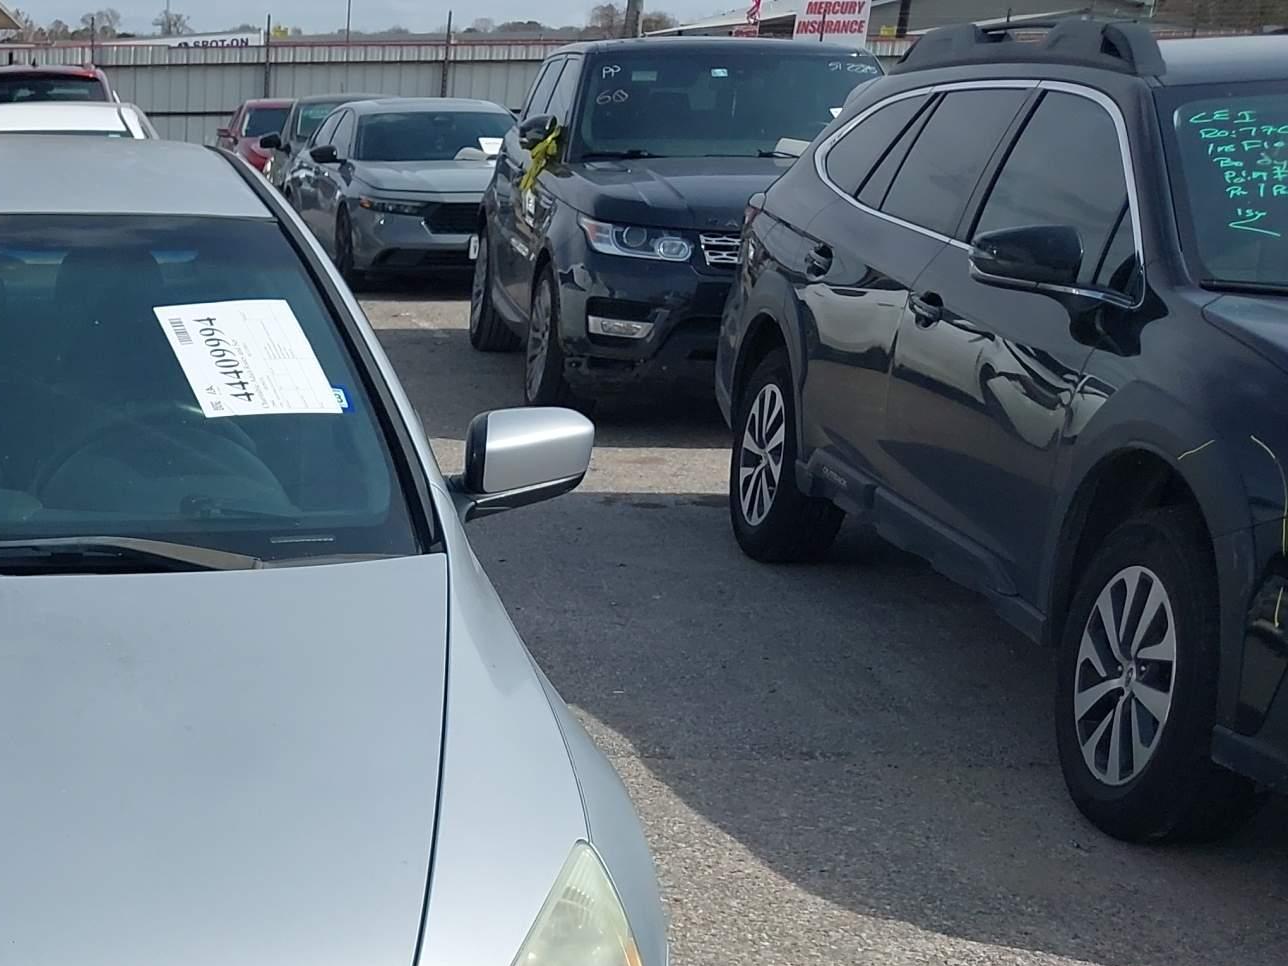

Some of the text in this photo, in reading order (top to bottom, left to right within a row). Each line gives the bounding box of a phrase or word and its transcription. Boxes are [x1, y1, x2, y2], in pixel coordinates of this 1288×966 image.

[806, 1, 866, 15] MERCURY
[796, 20, 866, 34] INSURANCE
[192, 316, 255, 402] 44409994
